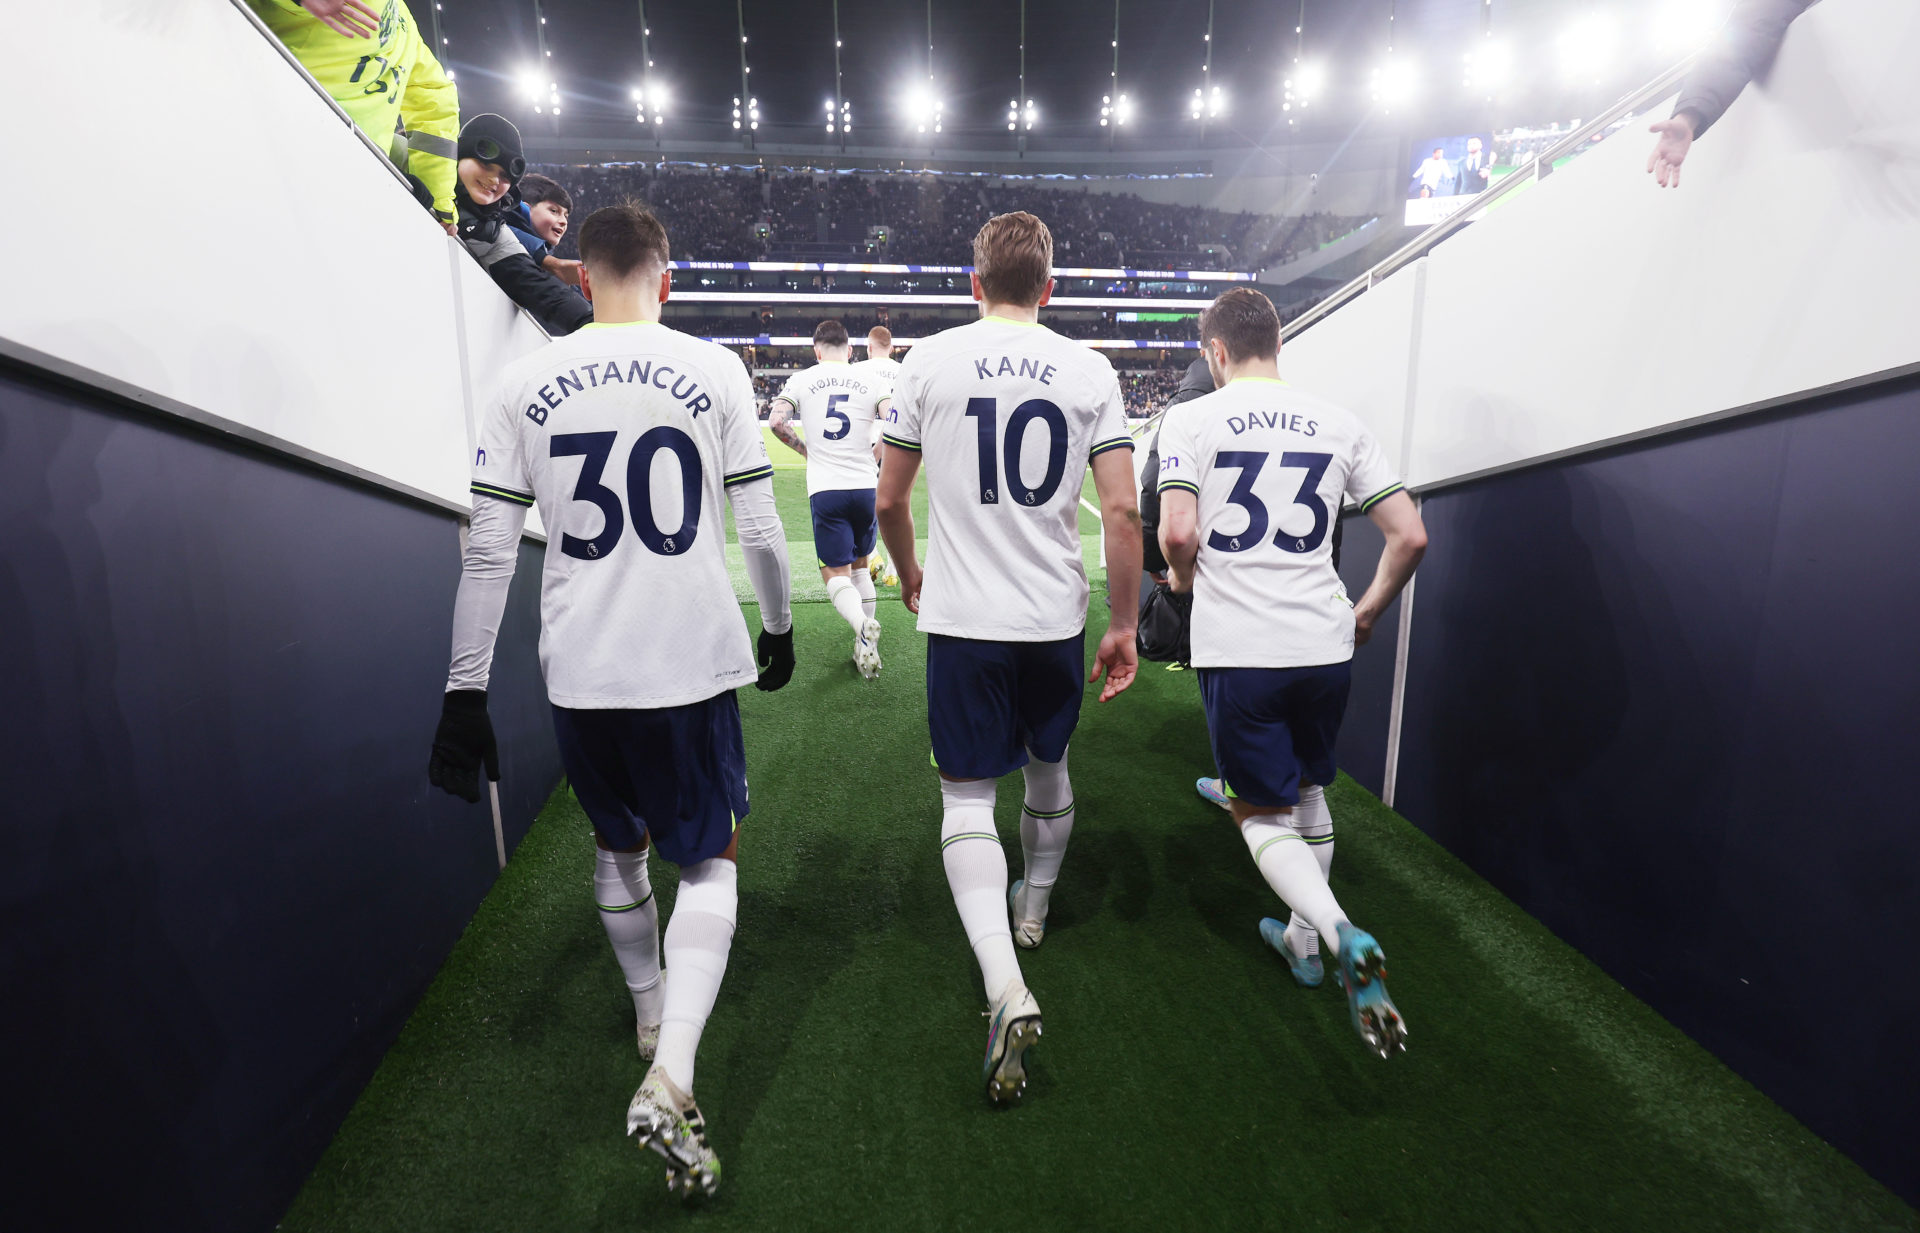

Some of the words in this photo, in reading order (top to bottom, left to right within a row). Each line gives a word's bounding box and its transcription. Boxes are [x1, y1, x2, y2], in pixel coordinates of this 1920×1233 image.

[525, 360, 712, 427] BENTANCUR
[808, 377, 868, 395] HØJBJERG
[974, 356, 1057, 386] KANE
[823, 394, 851, 440] 5
[1226, 411, 1319, 437] DAVIES
[965, 397, 1069, 507] 10
[549, 425, 703, 560] 30
[1207, 450, 1334, 554] 33
